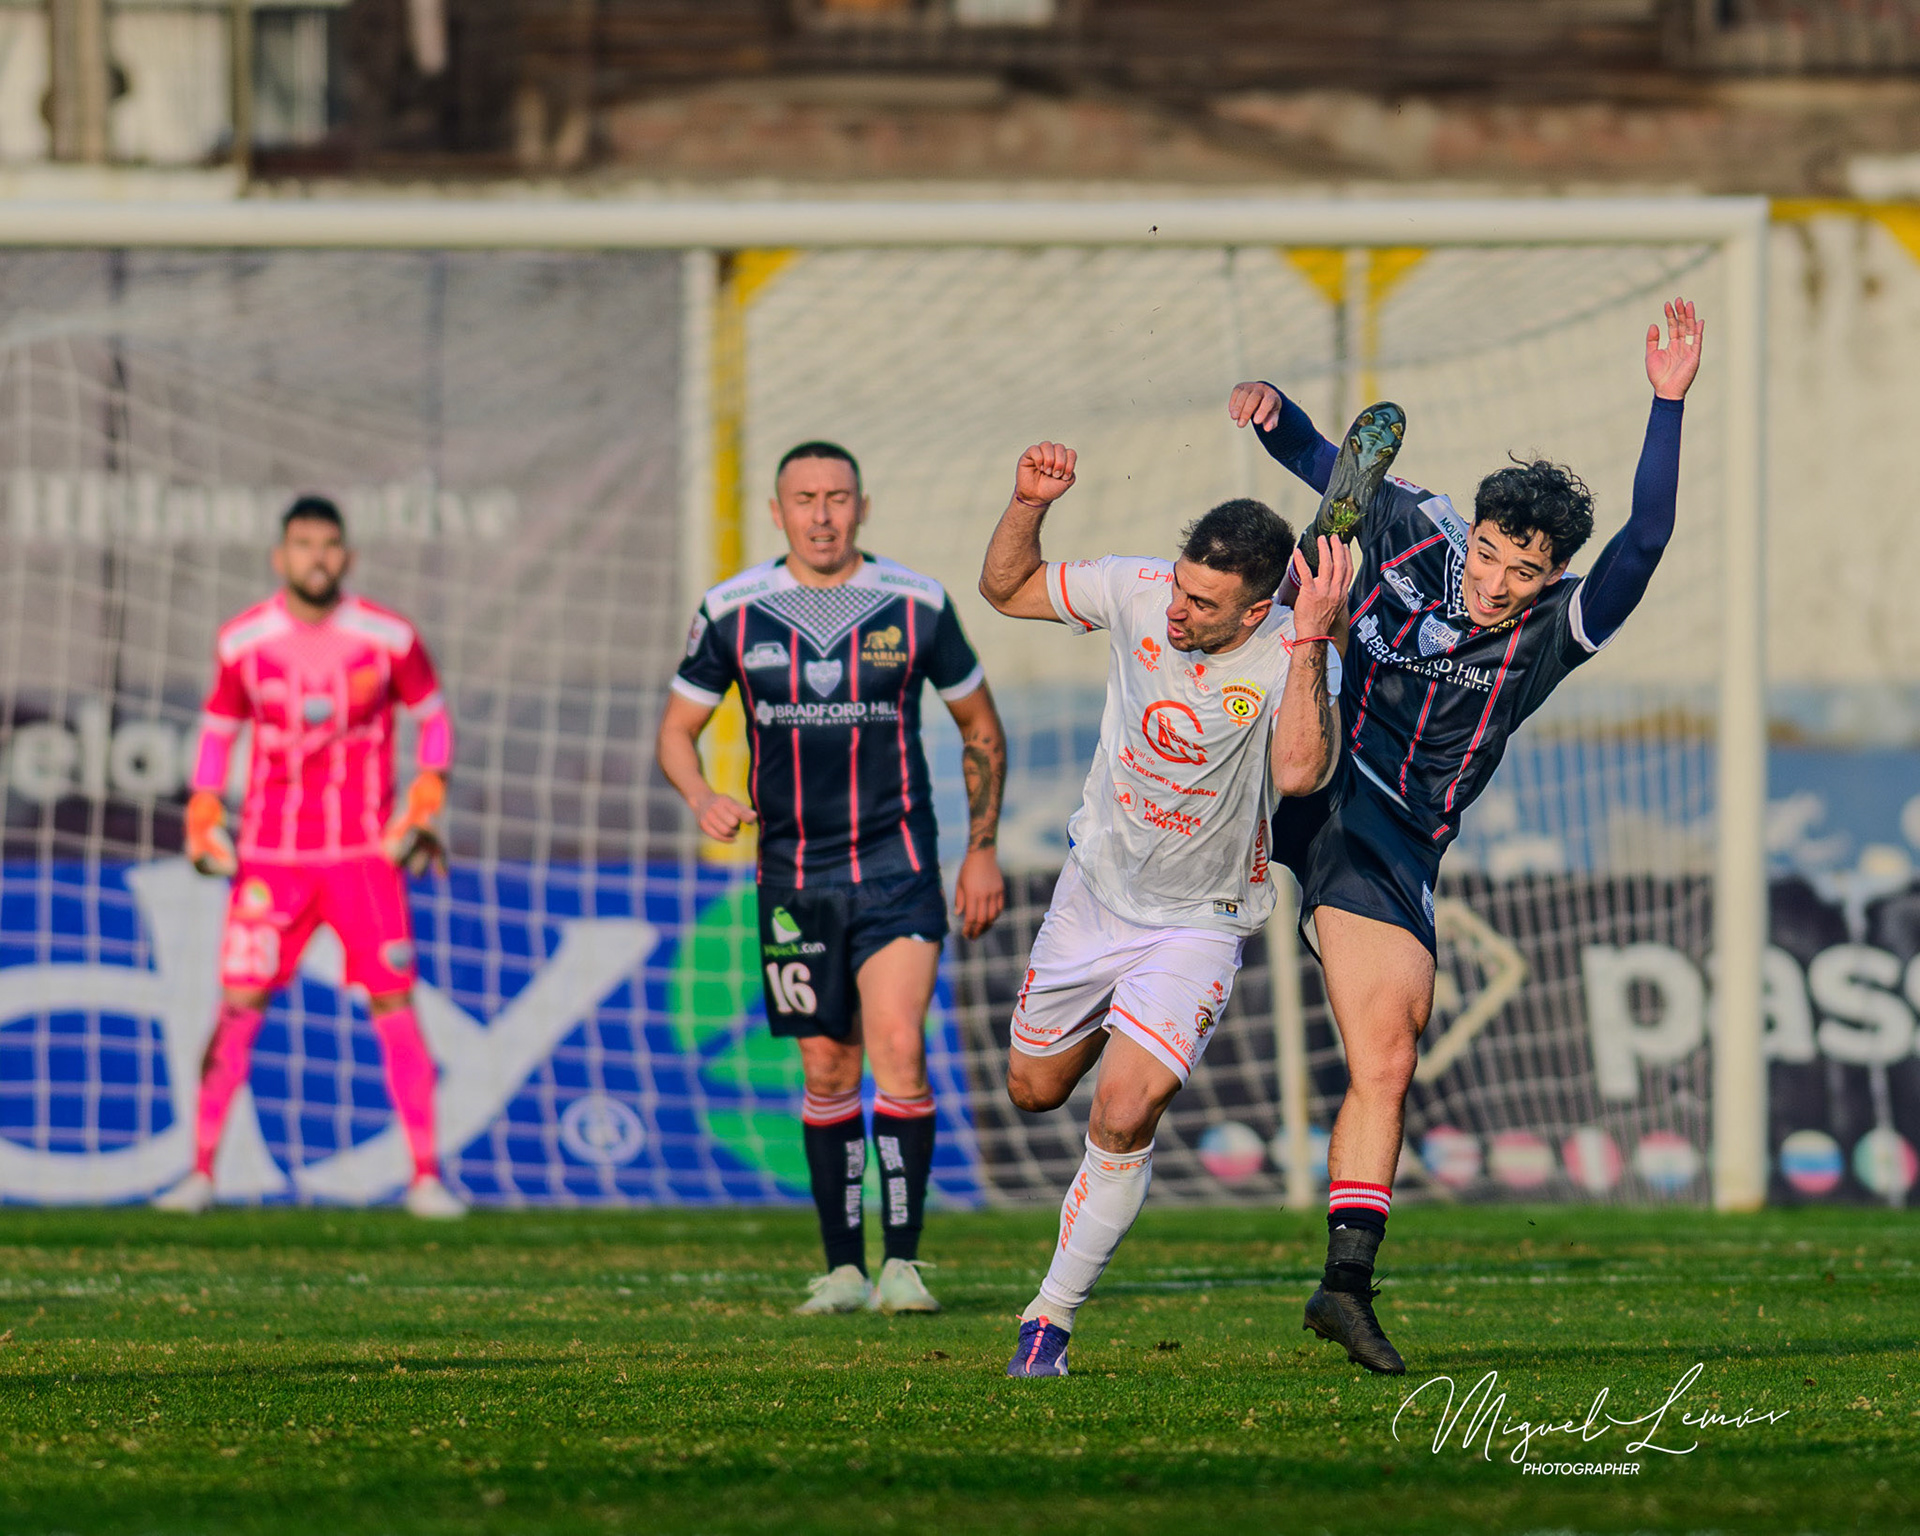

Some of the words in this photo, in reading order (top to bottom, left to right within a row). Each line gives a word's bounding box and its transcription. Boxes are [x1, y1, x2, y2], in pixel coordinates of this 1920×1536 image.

[1423, 620, 1456, 644] RECOLETA
[1369, 633, 1453, 674] BRARD
[1456, 662, 1492, 686] HILL
[1184, 669, 1210, 692] COLCO
[775, 703, 866, 718] BRADFORD
[870, 702, 898, 715] HILL
[1156, 711, 1177, 733] EL
[766, 961, 817, 1014] 16
